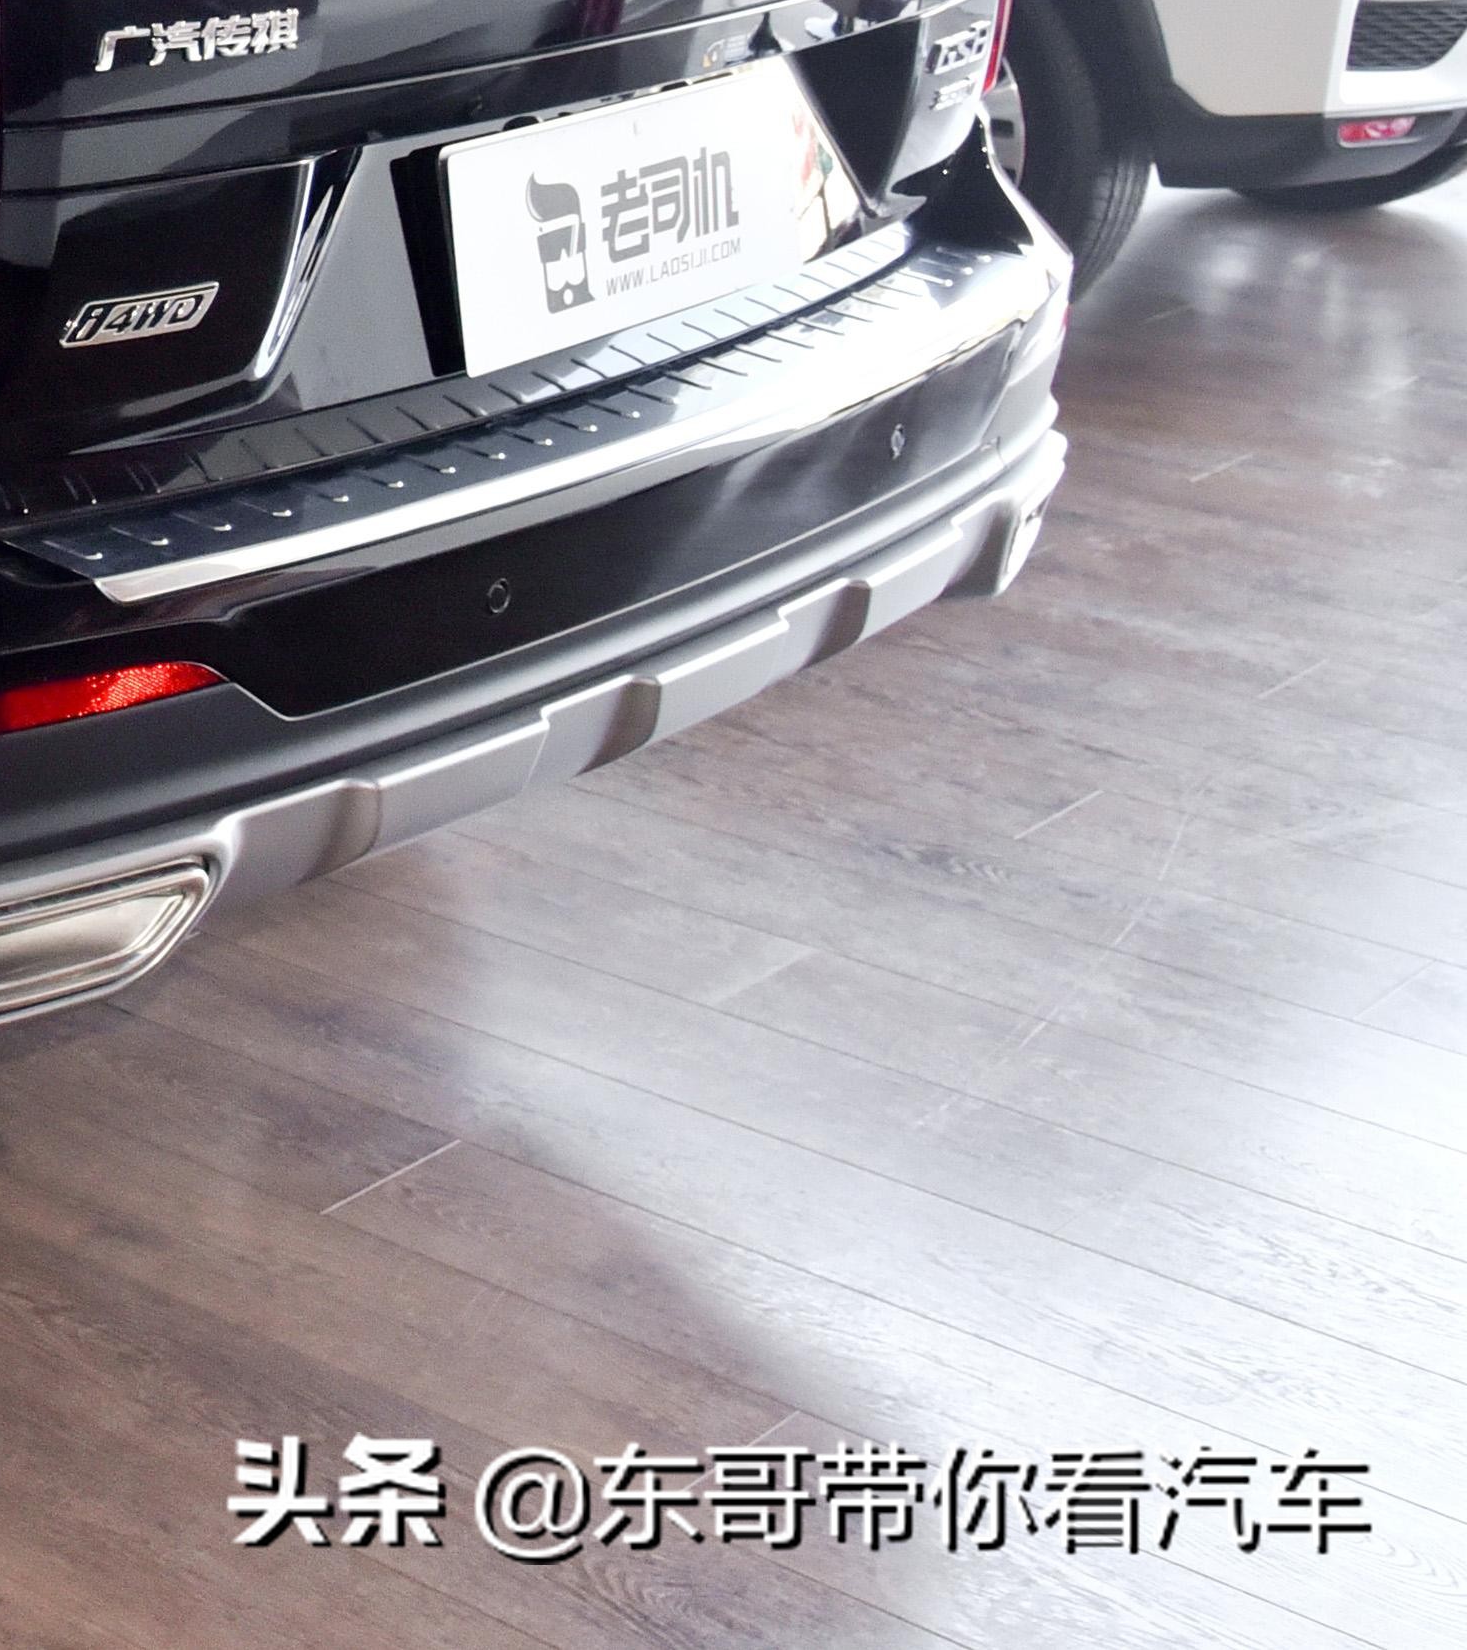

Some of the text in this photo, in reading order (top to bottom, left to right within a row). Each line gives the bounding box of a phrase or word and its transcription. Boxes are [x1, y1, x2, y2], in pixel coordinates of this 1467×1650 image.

[93, 7, 300, 73] 广汽传祺
[599, 145, 740, 264] 老司机
[604, 236, 742, 297] WWW.LAOSIJI.COM
